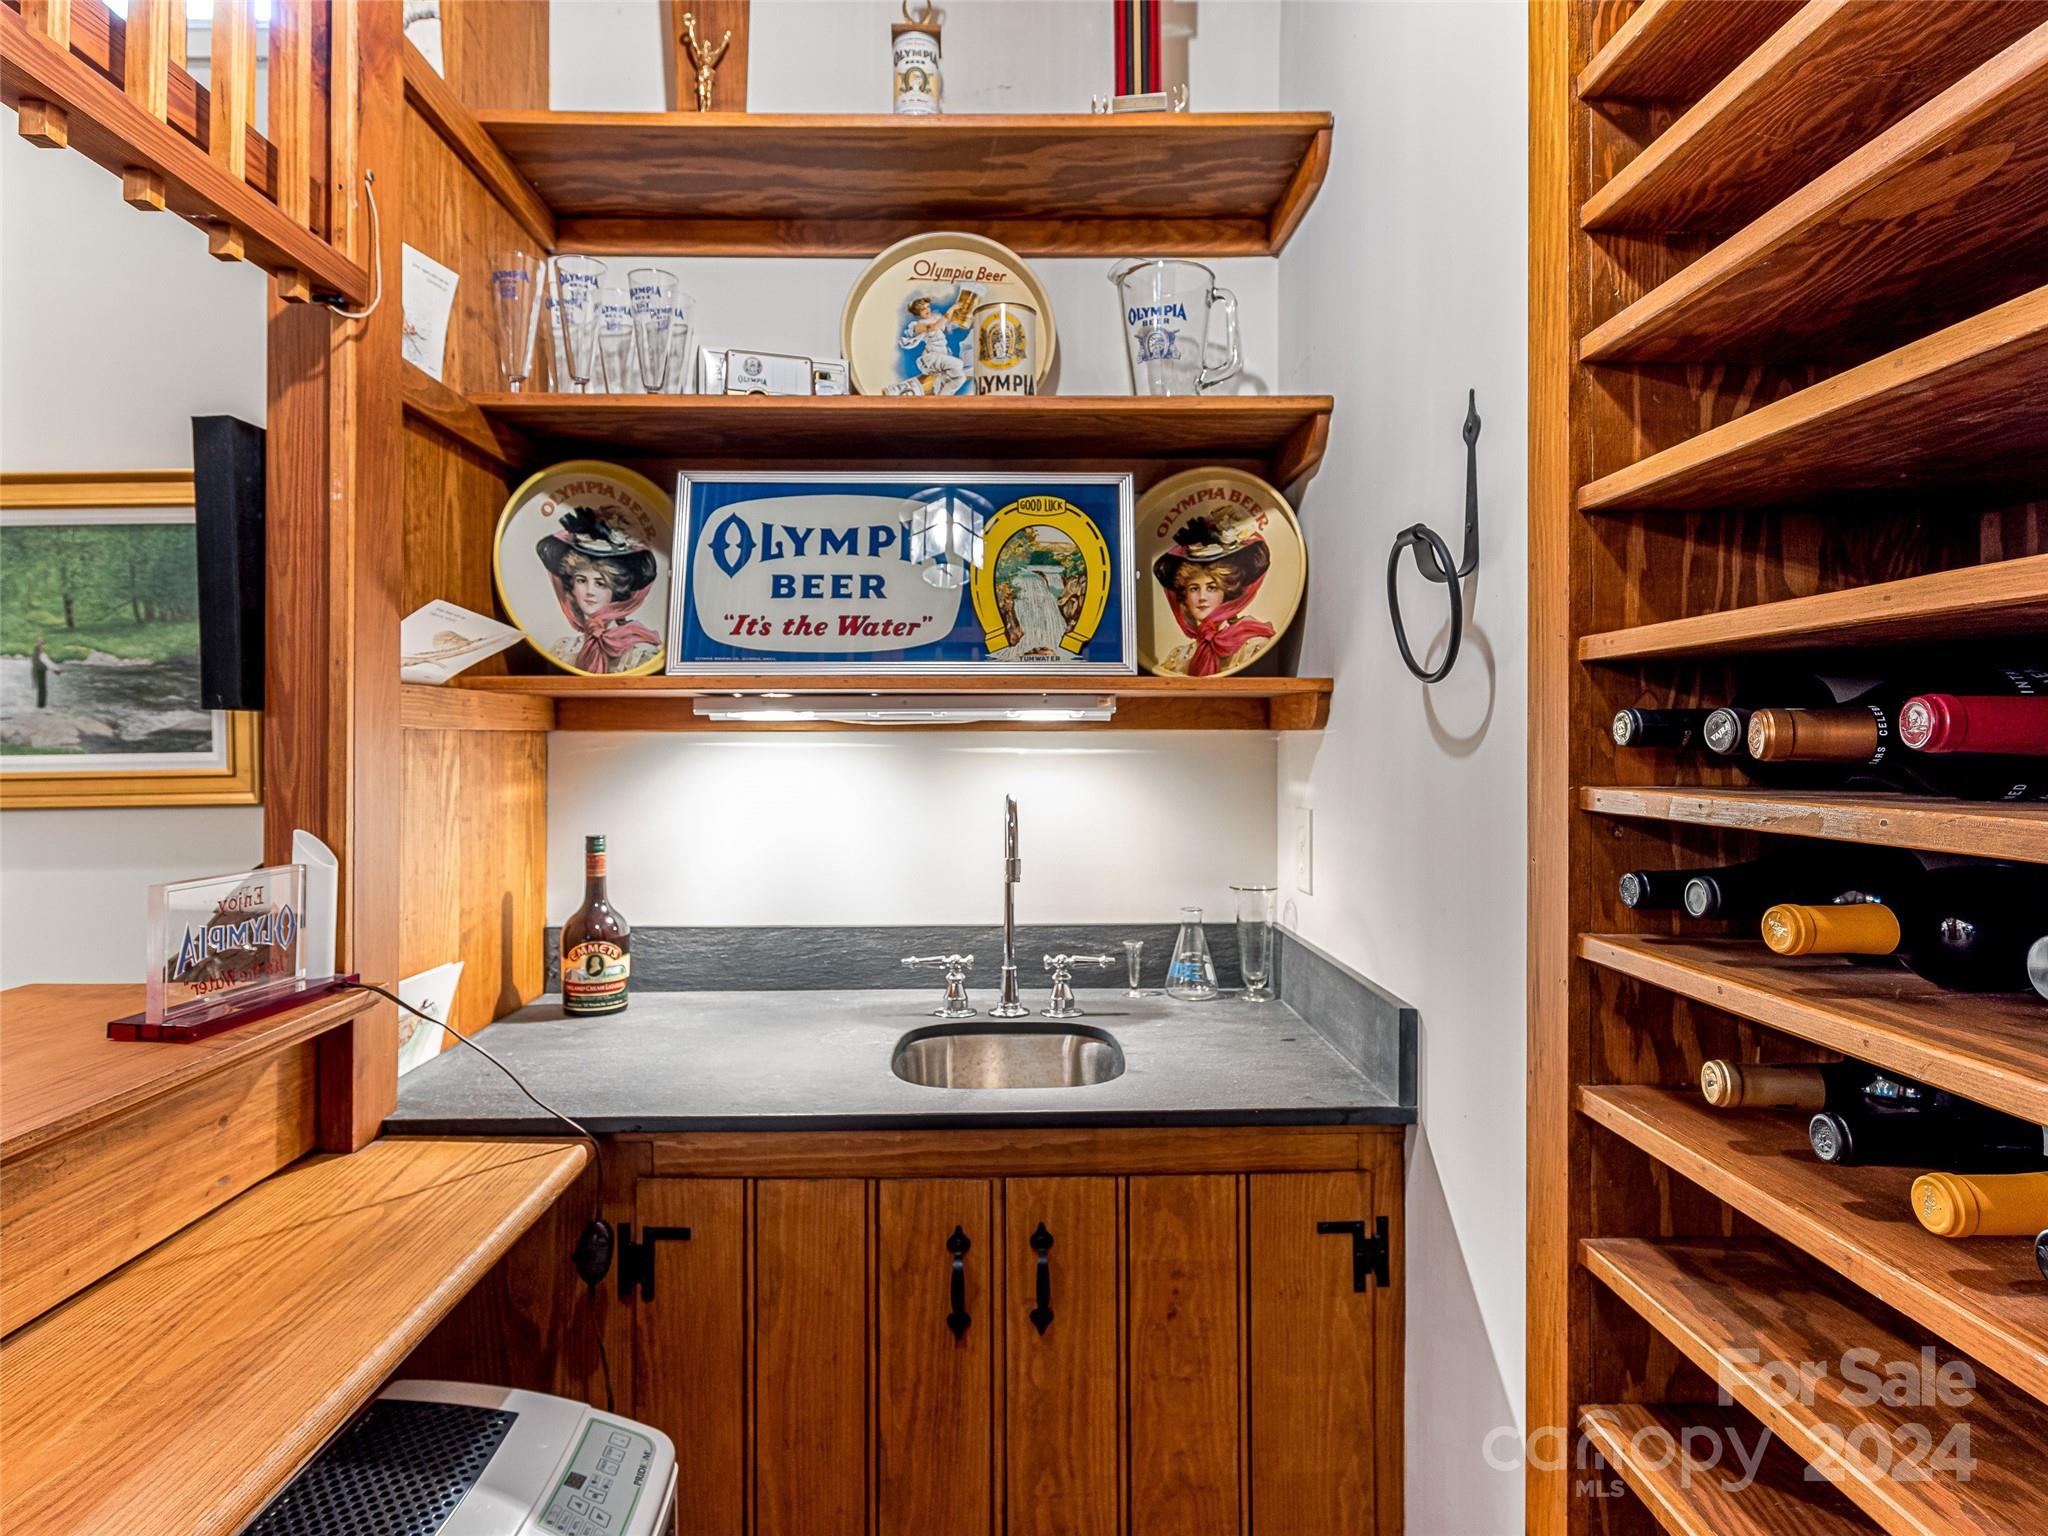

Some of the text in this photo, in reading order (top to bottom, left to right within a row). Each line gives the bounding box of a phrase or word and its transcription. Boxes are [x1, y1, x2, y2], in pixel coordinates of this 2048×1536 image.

[910, 259, 1008, 284] Olympia Beer
[1128, 303, 1187, 326] OLYMPIA
[1142, 319, 1170, 327] BEER
[738, 374, 767, 386] OLYMPIA
[541, 481, 657, 540] OLYMPIA BEER
[1019, 499, 1064, 512] GOOD LUCK
[1157, 488, 1270, 539] OLYMPIA BEER
[708, 512, 955, 578] OLYMPI
[771, 574, 887, 599] BEER
[782, 614, 827, 636] the
[836, 613, 933, 637] Water"
[1018, 655, 1062, 663] TUMWATER
[570, 943, 620, 961] EMMETS
